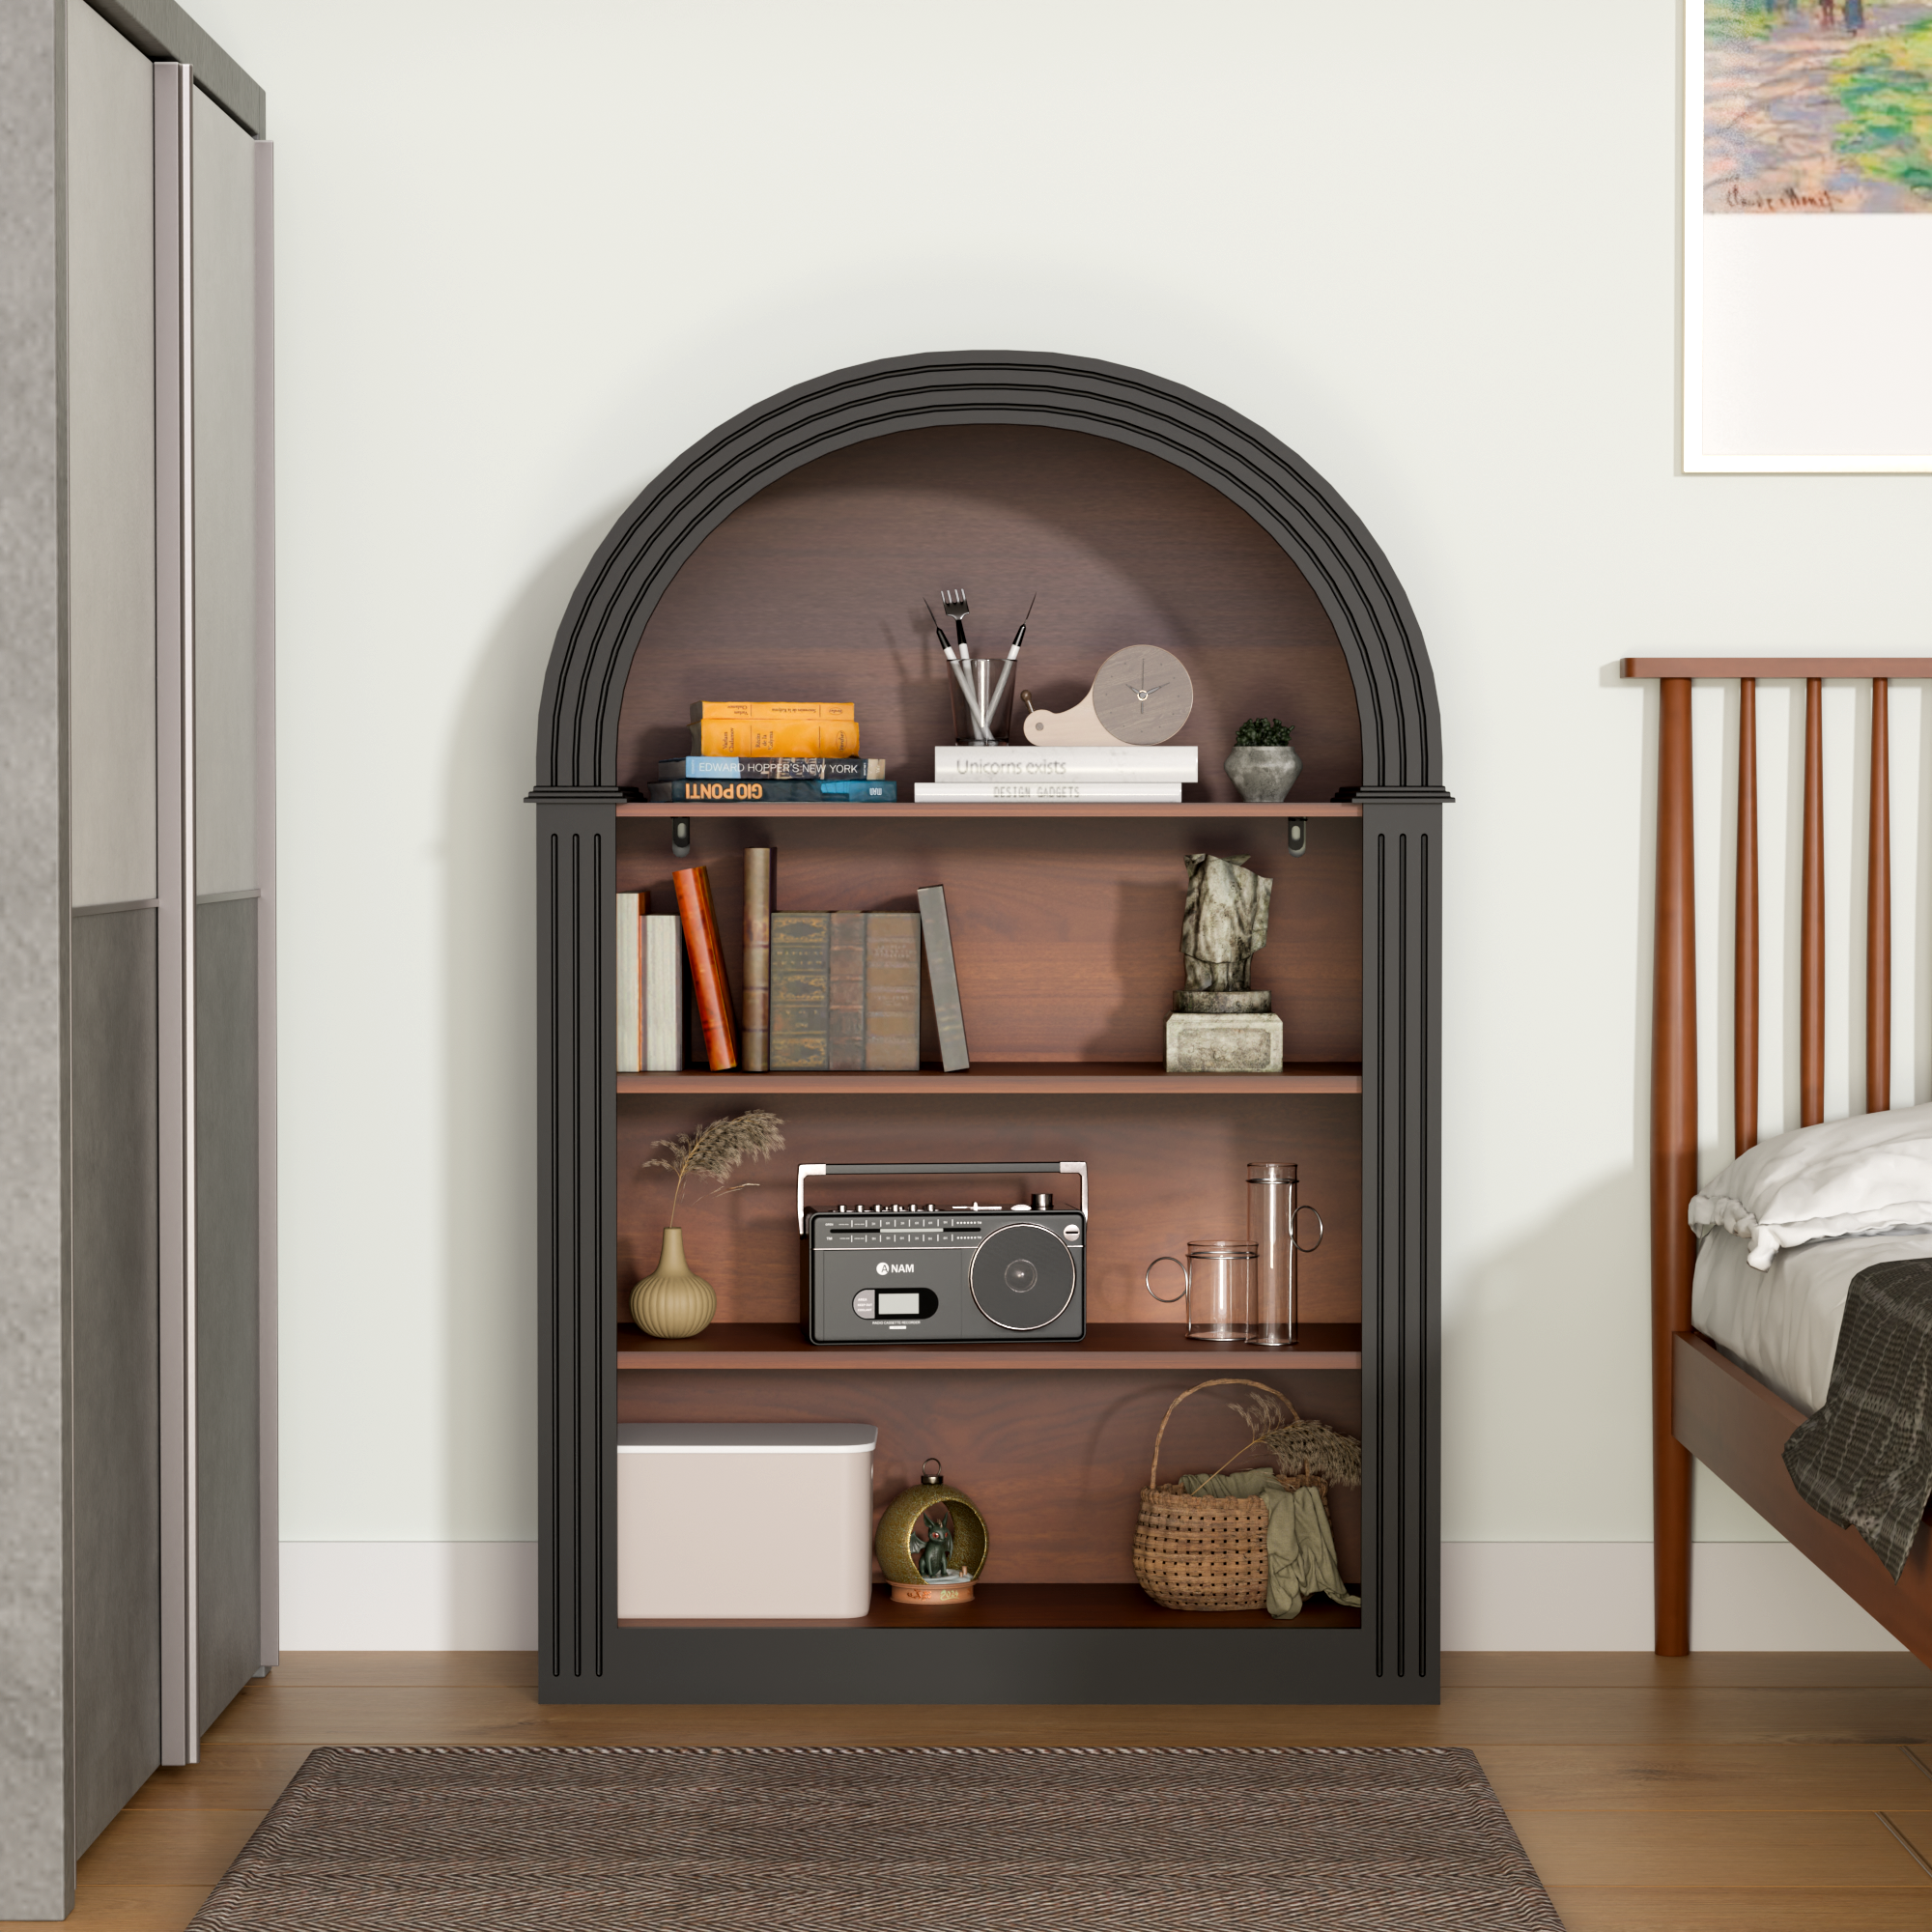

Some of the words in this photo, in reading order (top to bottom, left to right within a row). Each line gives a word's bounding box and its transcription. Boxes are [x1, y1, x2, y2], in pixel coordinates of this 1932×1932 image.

[699, 762, 744, 772] EDWARD
[747, 763, 800, 773] HOPPER'S
[802, 763, 826, 773] NEW
[829, 764, 858, 773] YORK
[956, 759, 1022, 775] Unicorns
[1026, 760, 1067, 775] exists
[685, 783, 734, 799] PONTI
[736, 783, 763, 799] GIO
[993, 787, 1031, 798] DESIGN
[1037, 787, 1080, 798] GADGETS
